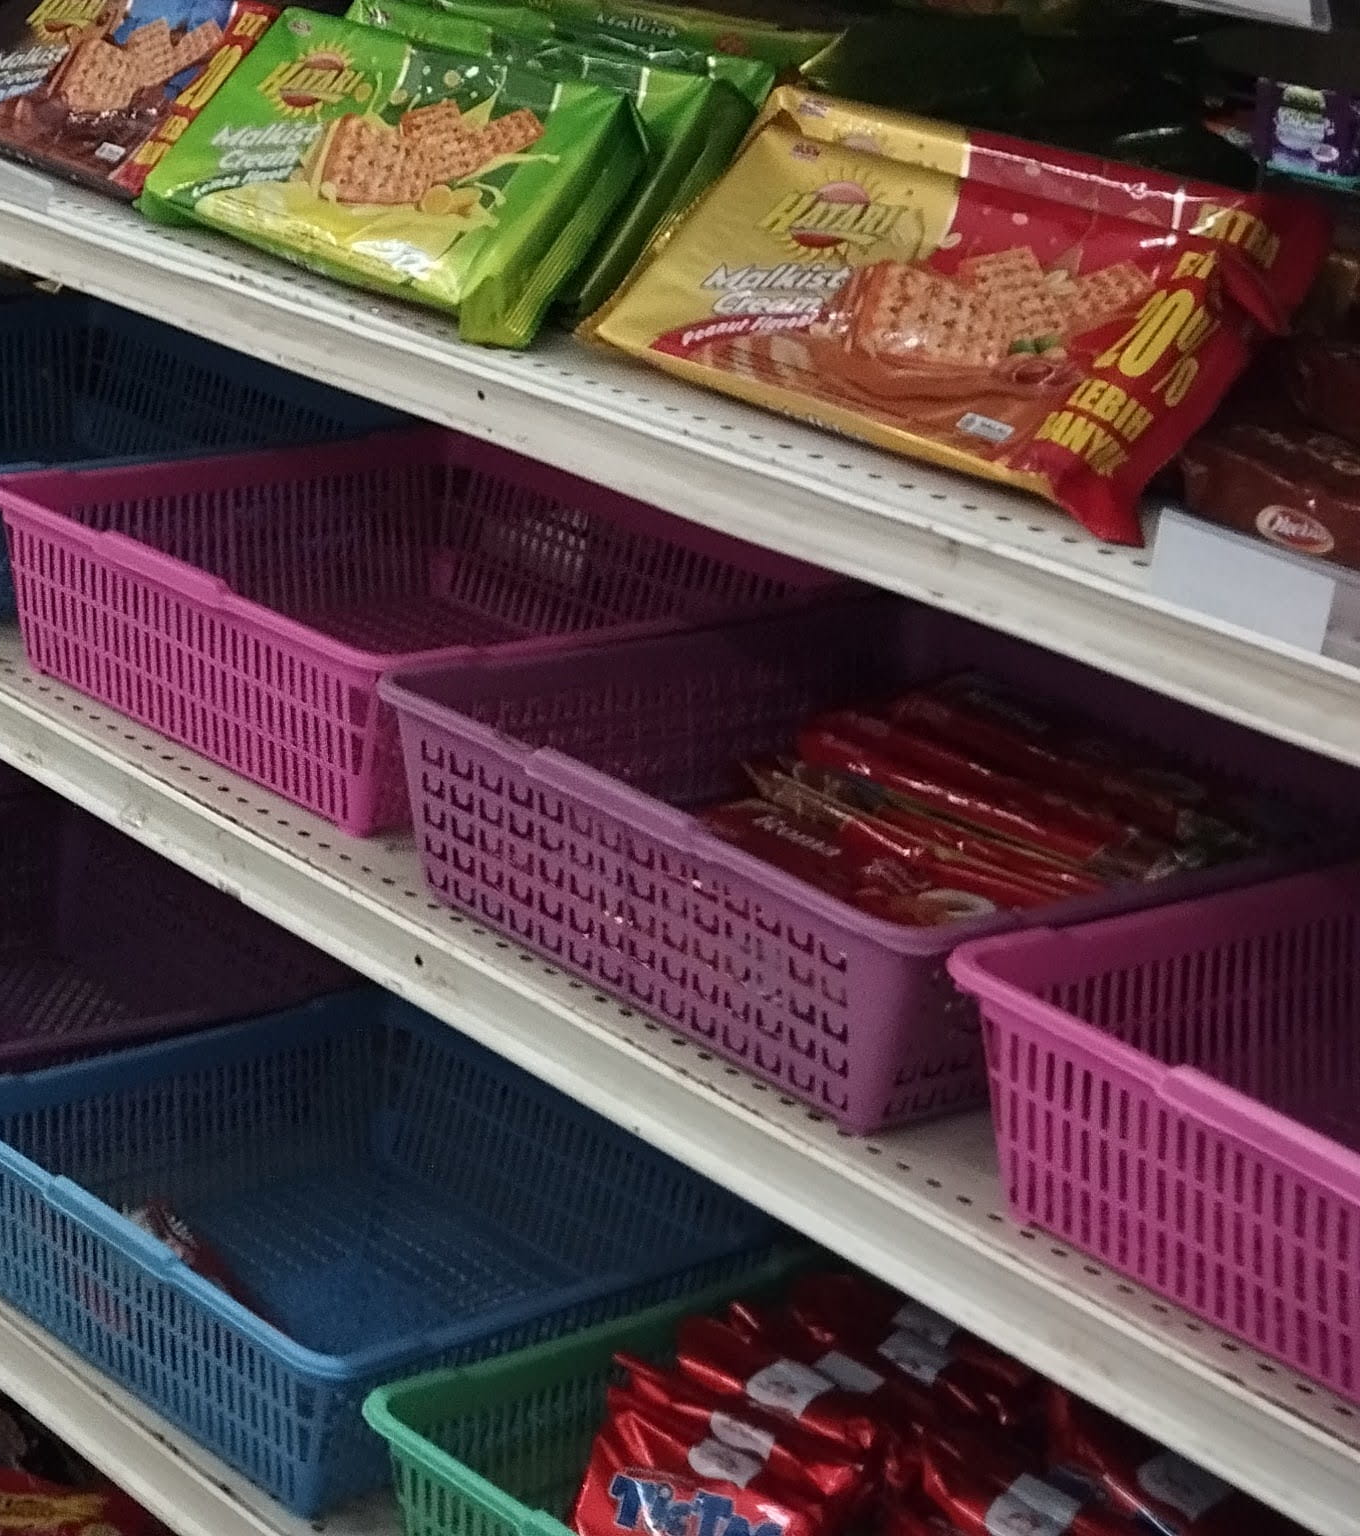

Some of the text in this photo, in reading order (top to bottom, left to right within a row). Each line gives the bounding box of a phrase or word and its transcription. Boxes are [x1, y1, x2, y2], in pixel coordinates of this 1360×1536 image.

[211, 120, 324, 147] Malkist
[754, 190, 908, 237] HATARI
[700, 263, 854, 290] Malkist
[711, 289, 825, 315] Cream
